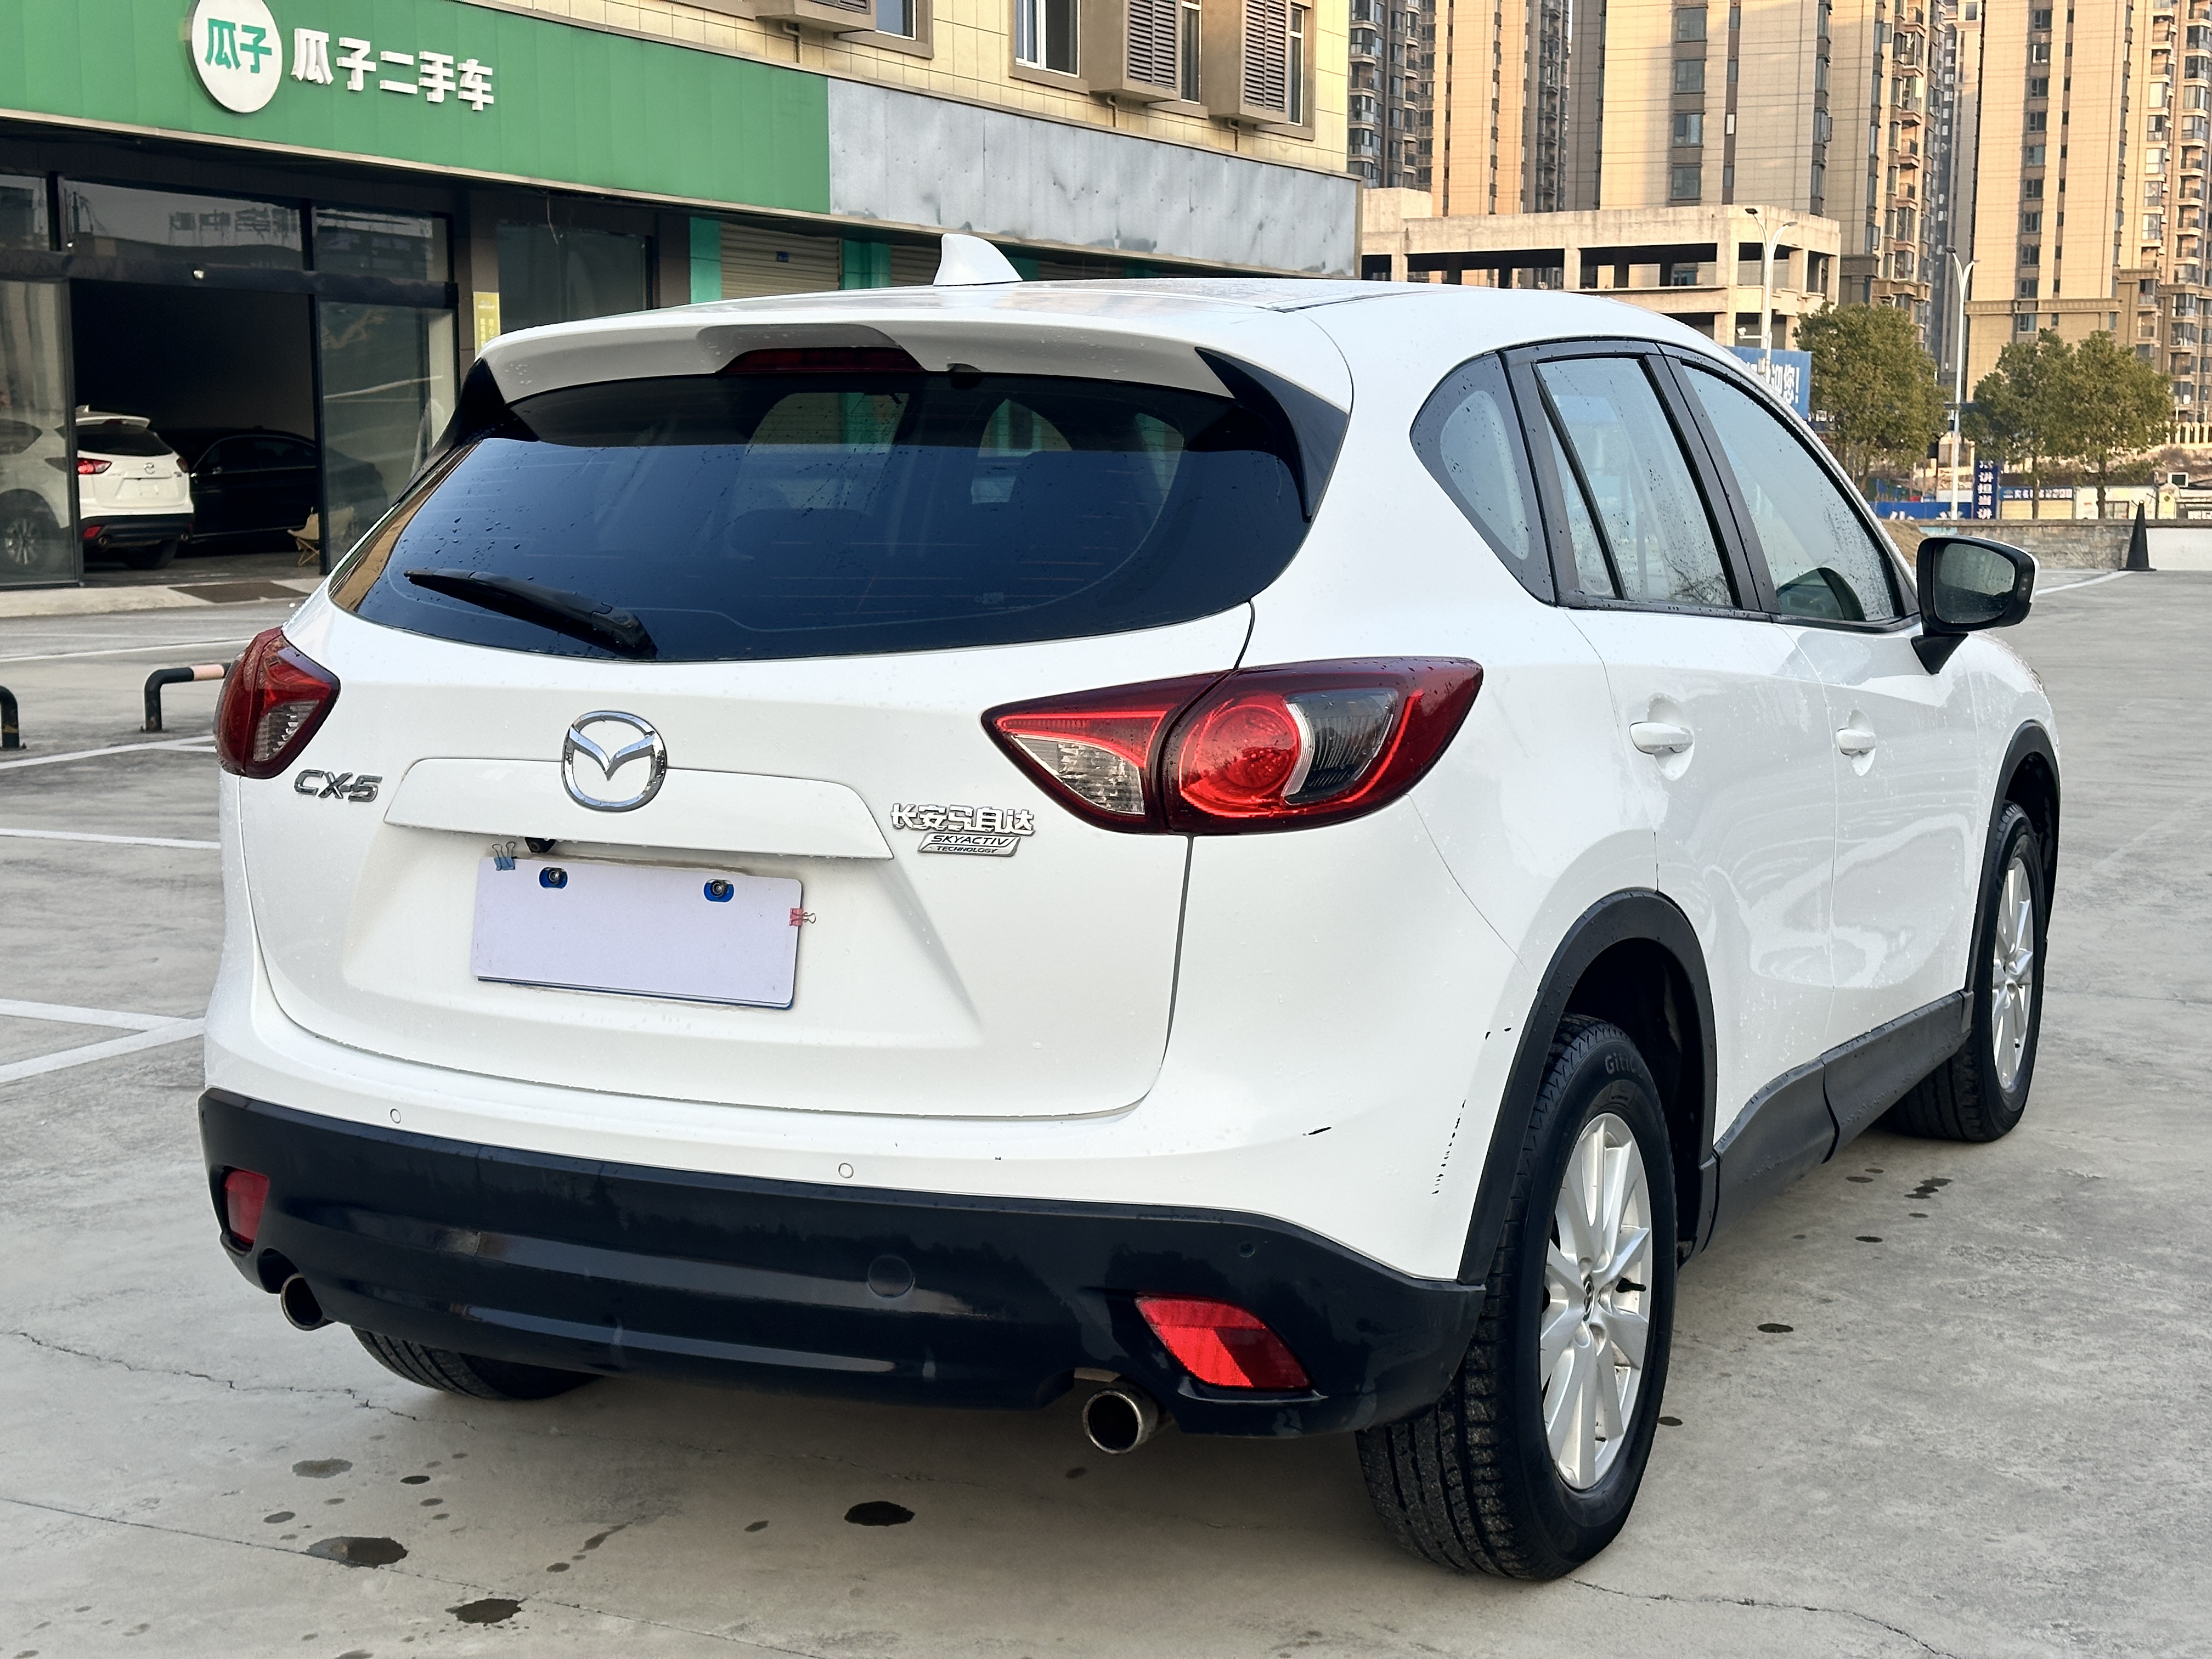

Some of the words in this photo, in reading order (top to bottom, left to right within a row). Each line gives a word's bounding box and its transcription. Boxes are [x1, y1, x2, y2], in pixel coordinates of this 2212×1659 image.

[205, 18, 272, 74] 瓜子
[290, 28, 494, 111] 瓜子二手车
[294, 769, 383, 802] CX-5
[890, 803, 1035, 836] 长安马自达
[931, 835, 1009, 845] SKYACTIV
